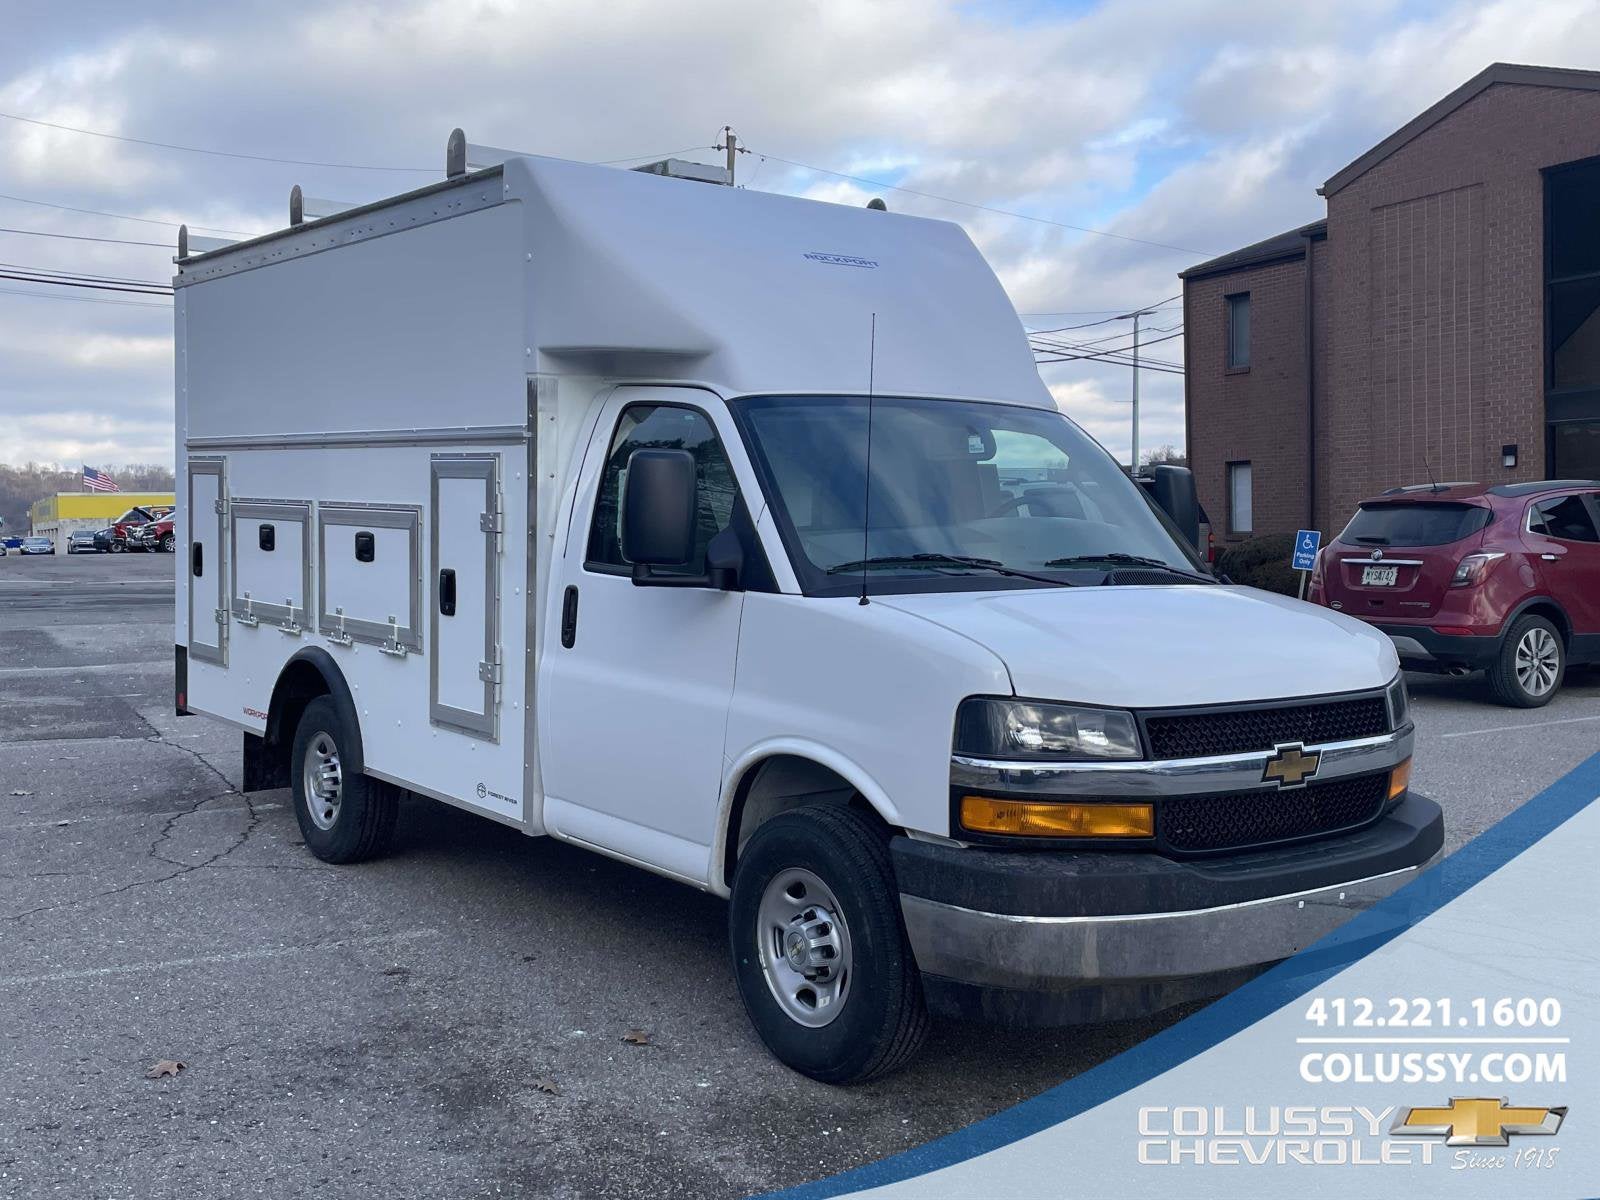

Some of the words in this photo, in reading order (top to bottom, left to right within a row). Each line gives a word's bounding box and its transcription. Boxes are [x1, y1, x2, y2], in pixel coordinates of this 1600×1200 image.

[803, 253, 879, 267] ROCKPORT
[1296, 551, 1315, 560] Parking
[487, 790, 504, 801] FOREST
[504, 796, 518, 804] RIVER
